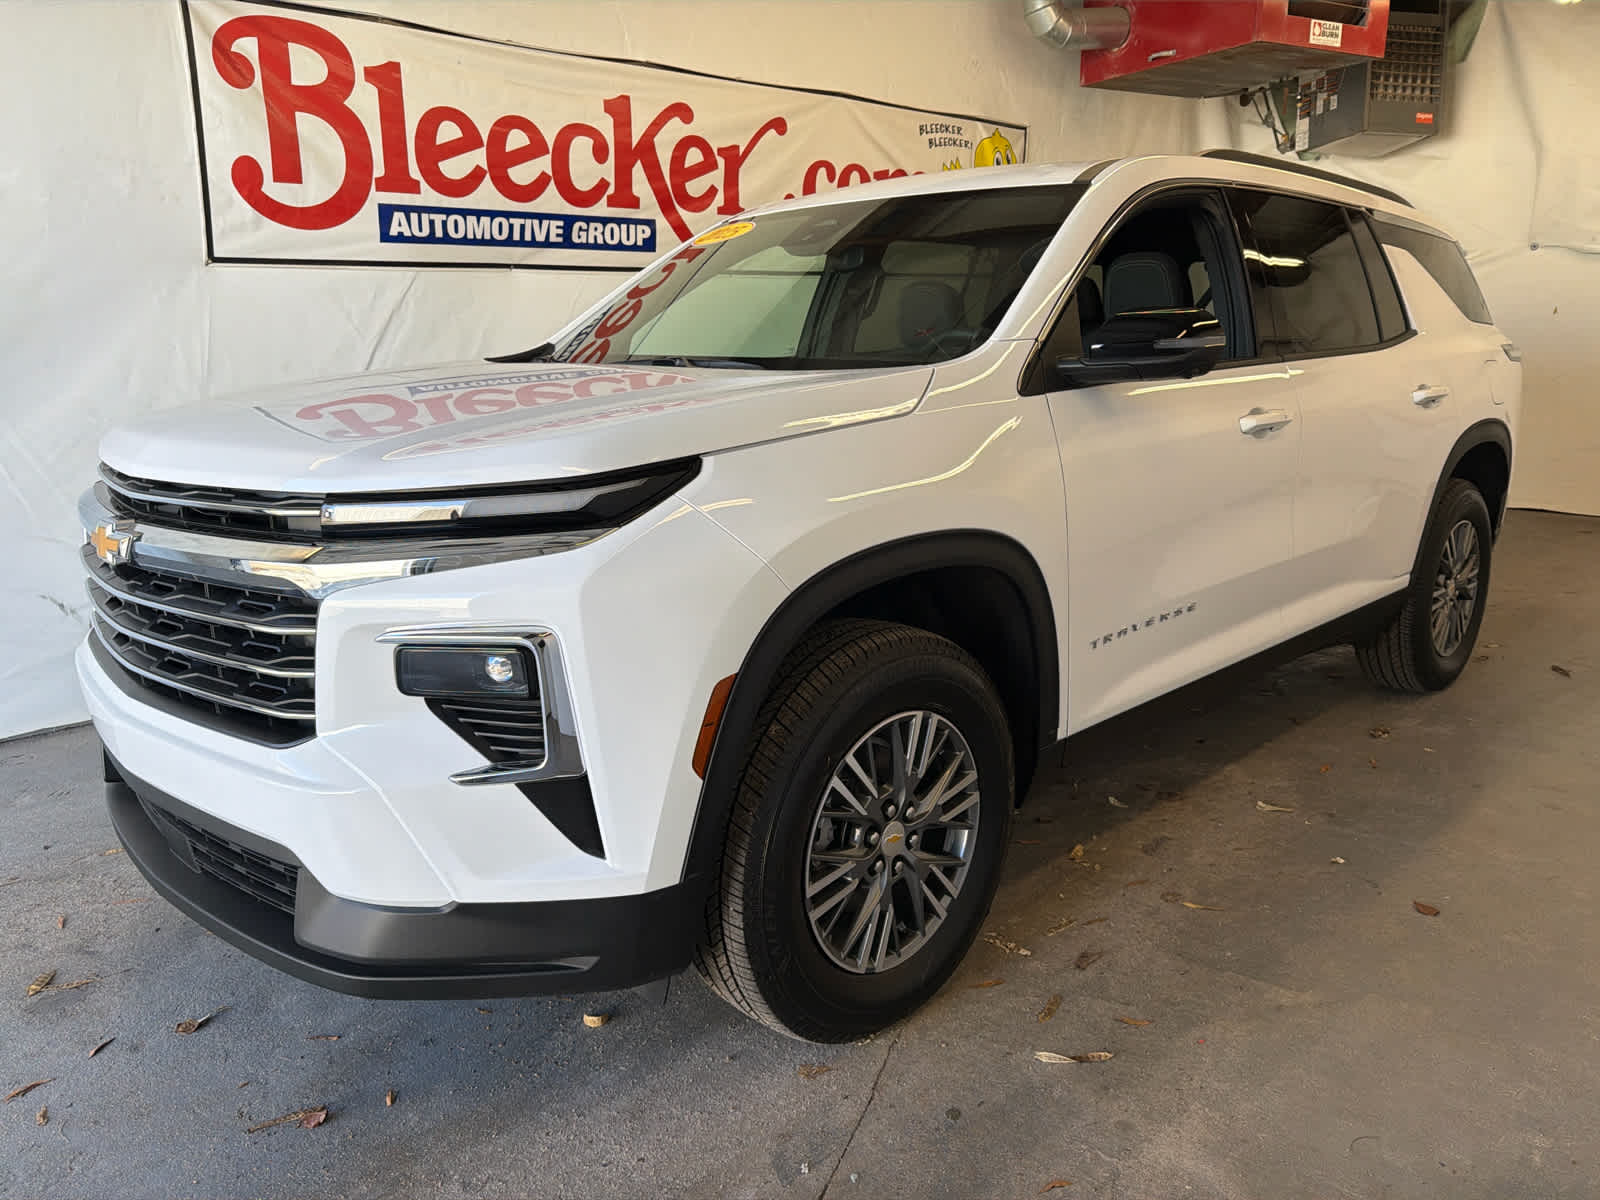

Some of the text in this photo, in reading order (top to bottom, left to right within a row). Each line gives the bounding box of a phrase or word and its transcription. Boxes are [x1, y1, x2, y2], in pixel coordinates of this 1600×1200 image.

[1322, 30, 1339, 38] BURN
[919, 123, 963, 136] BLEECKER
[389, 211, 652, 247] AUTOMOTIVE GROUP
[1090, 602, 1197, 649] TRAVERSE
